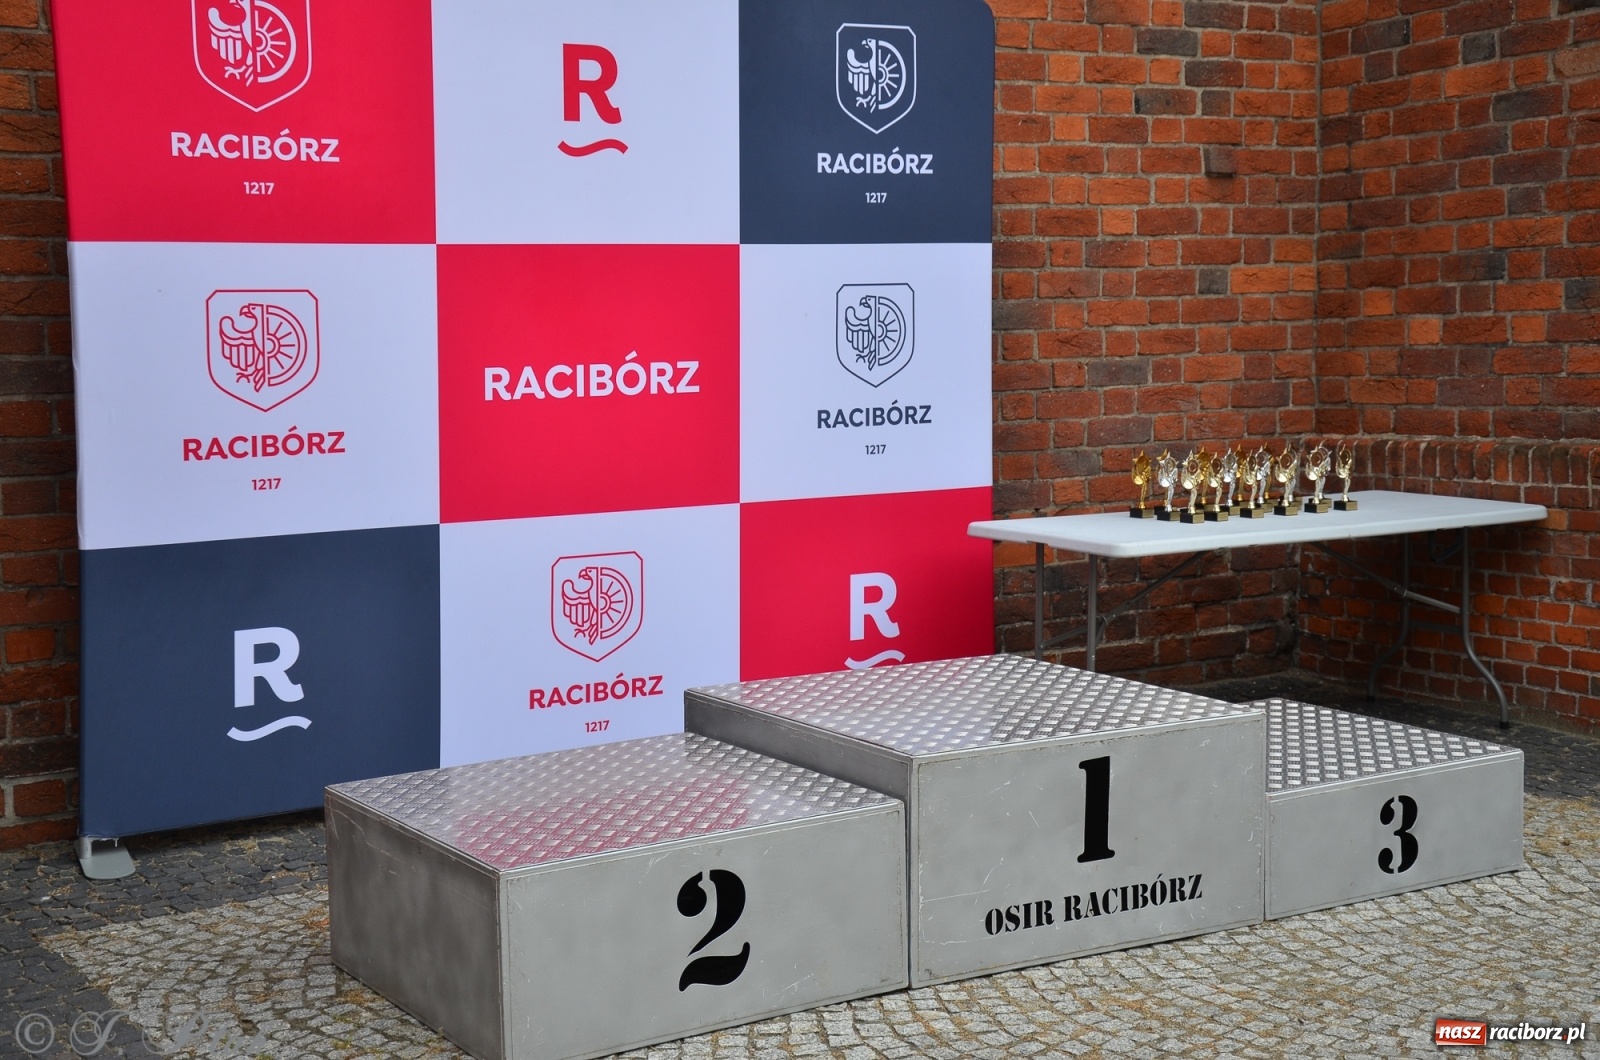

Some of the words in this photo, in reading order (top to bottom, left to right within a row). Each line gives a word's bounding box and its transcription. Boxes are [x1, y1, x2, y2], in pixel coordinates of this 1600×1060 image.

[562, 43, 622, 125] R
[170, 128, 340, 164] RACIBÓRZ
[817, 146, 934, 176] RACIBÓRZ
[243, 181, 275, 196] 1217
[865, 191, 887, 204] 1217
[484, 351, 700, 401] RACIBÓRZ
[817, 400, 932, 429] RACIBÓRZ
[183, 425, 346, 462] RACIBÓRZ
[865, 444, 887, 455] 1217
[251, 477, 282, 491] 1217
[850, 571, 900, 641] R
[234, 626, 305, 708] R
[529, 672, 664, 710] RACIBÓRZ
[585, 719, 610, 733] 1217
[1077, 756, 1116, 863] 1
[1378, 795, 1419, 875] 3
[984, 899, 1055, 936] OSIR
[1063, 873, 1204, 922] RACIBÓRZ
[677, 870, 751, 992] 2
